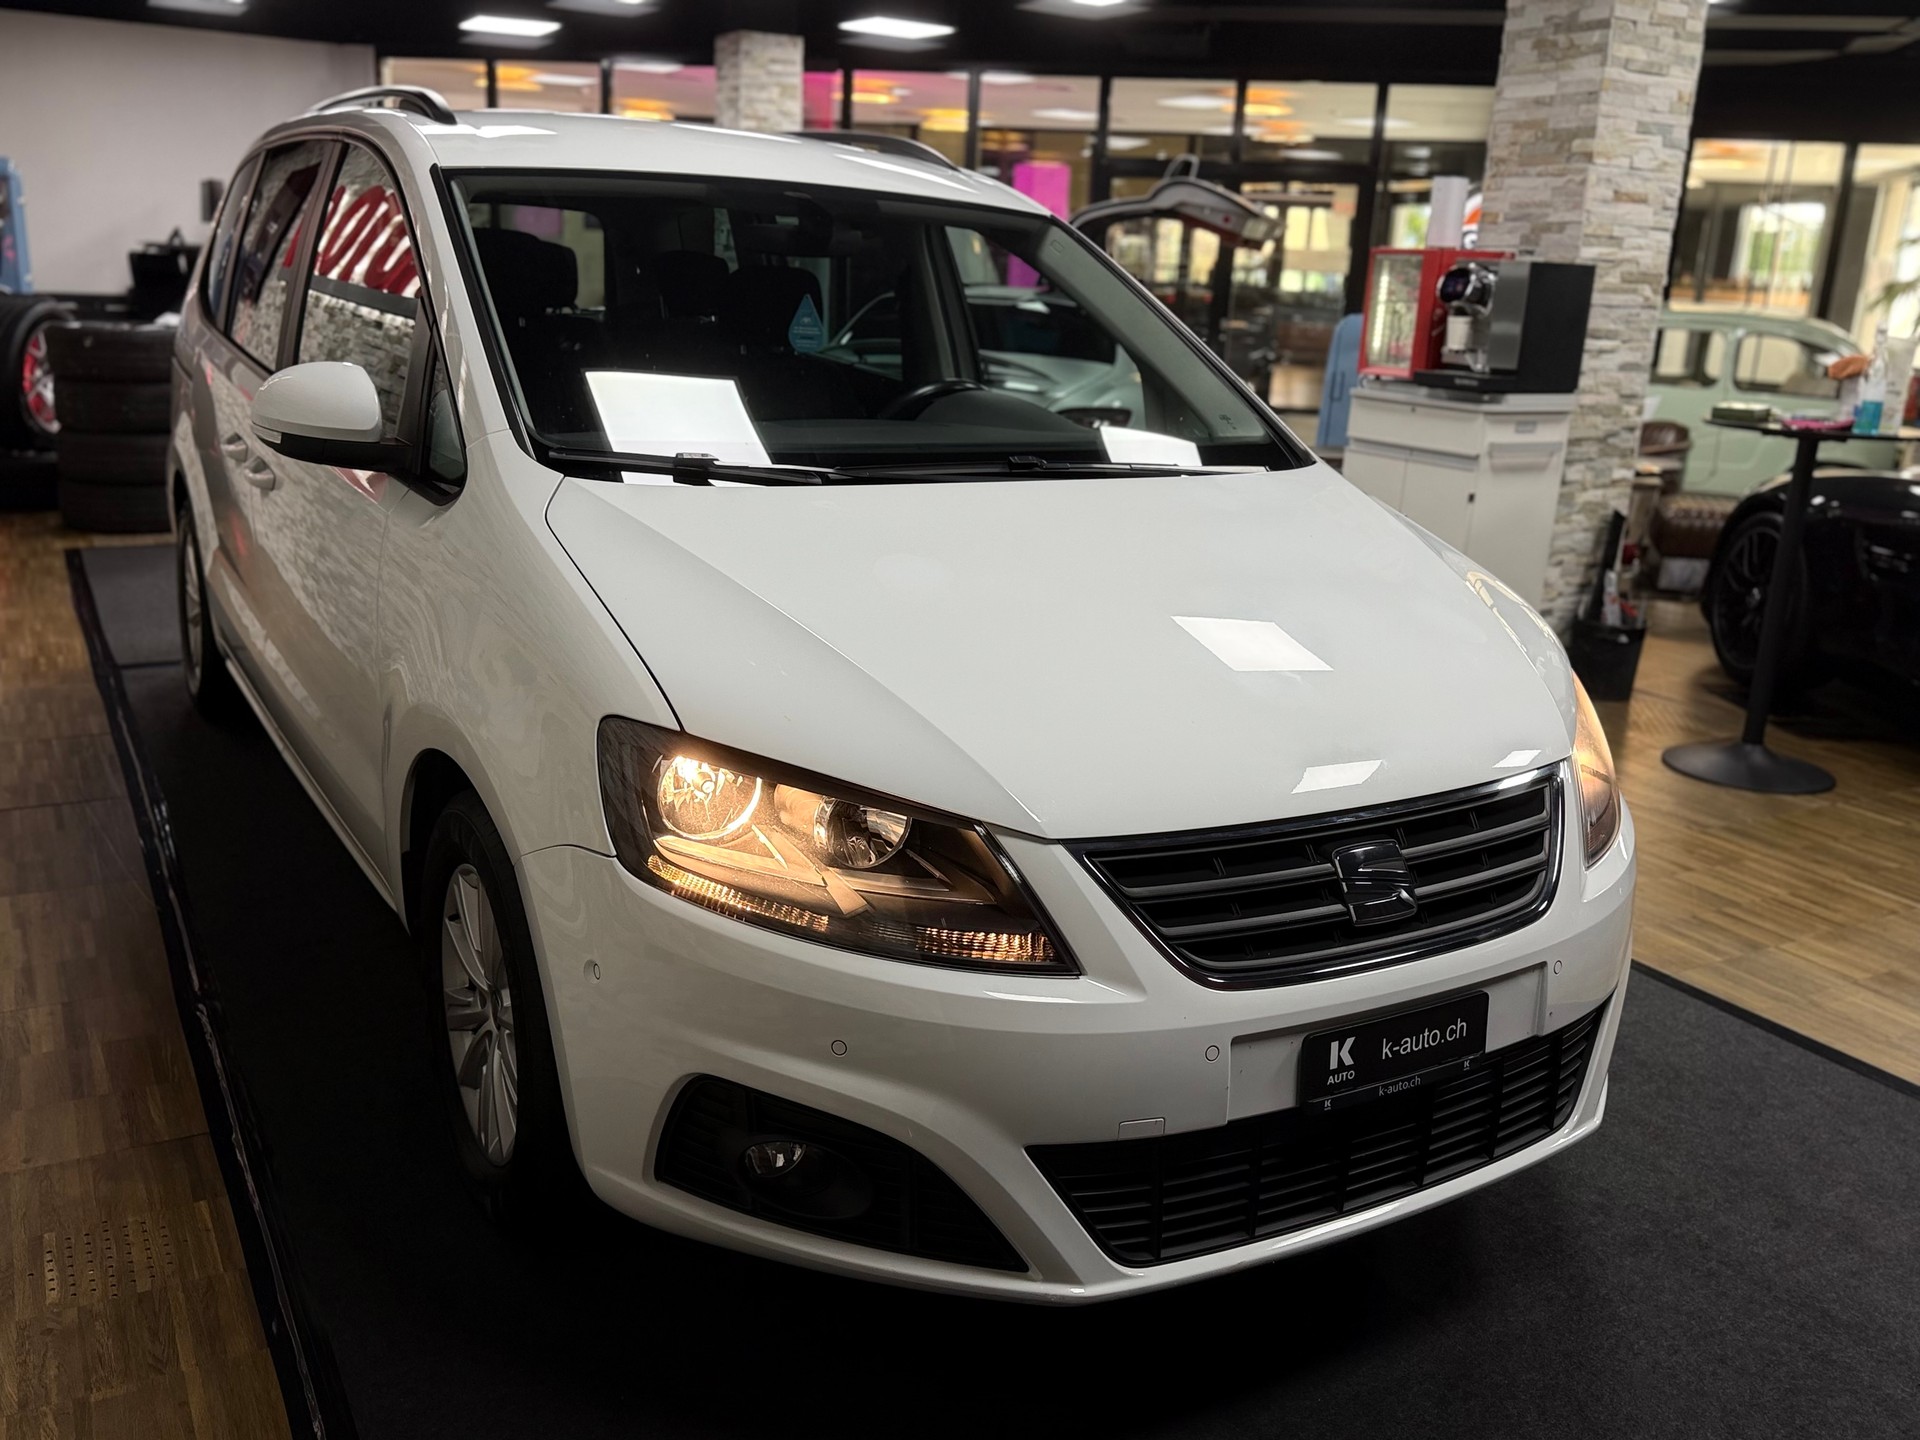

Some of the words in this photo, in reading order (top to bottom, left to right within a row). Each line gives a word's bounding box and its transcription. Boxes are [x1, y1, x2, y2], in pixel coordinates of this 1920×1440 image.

[1382, 1018, 1467, 1060] k-auto.ch
[1329, 1036, 1356, 1070] K
[1327, 1070, 1355, 1086] AUTO
[1379, 1076, 1421, 1097] k-auto.ch
